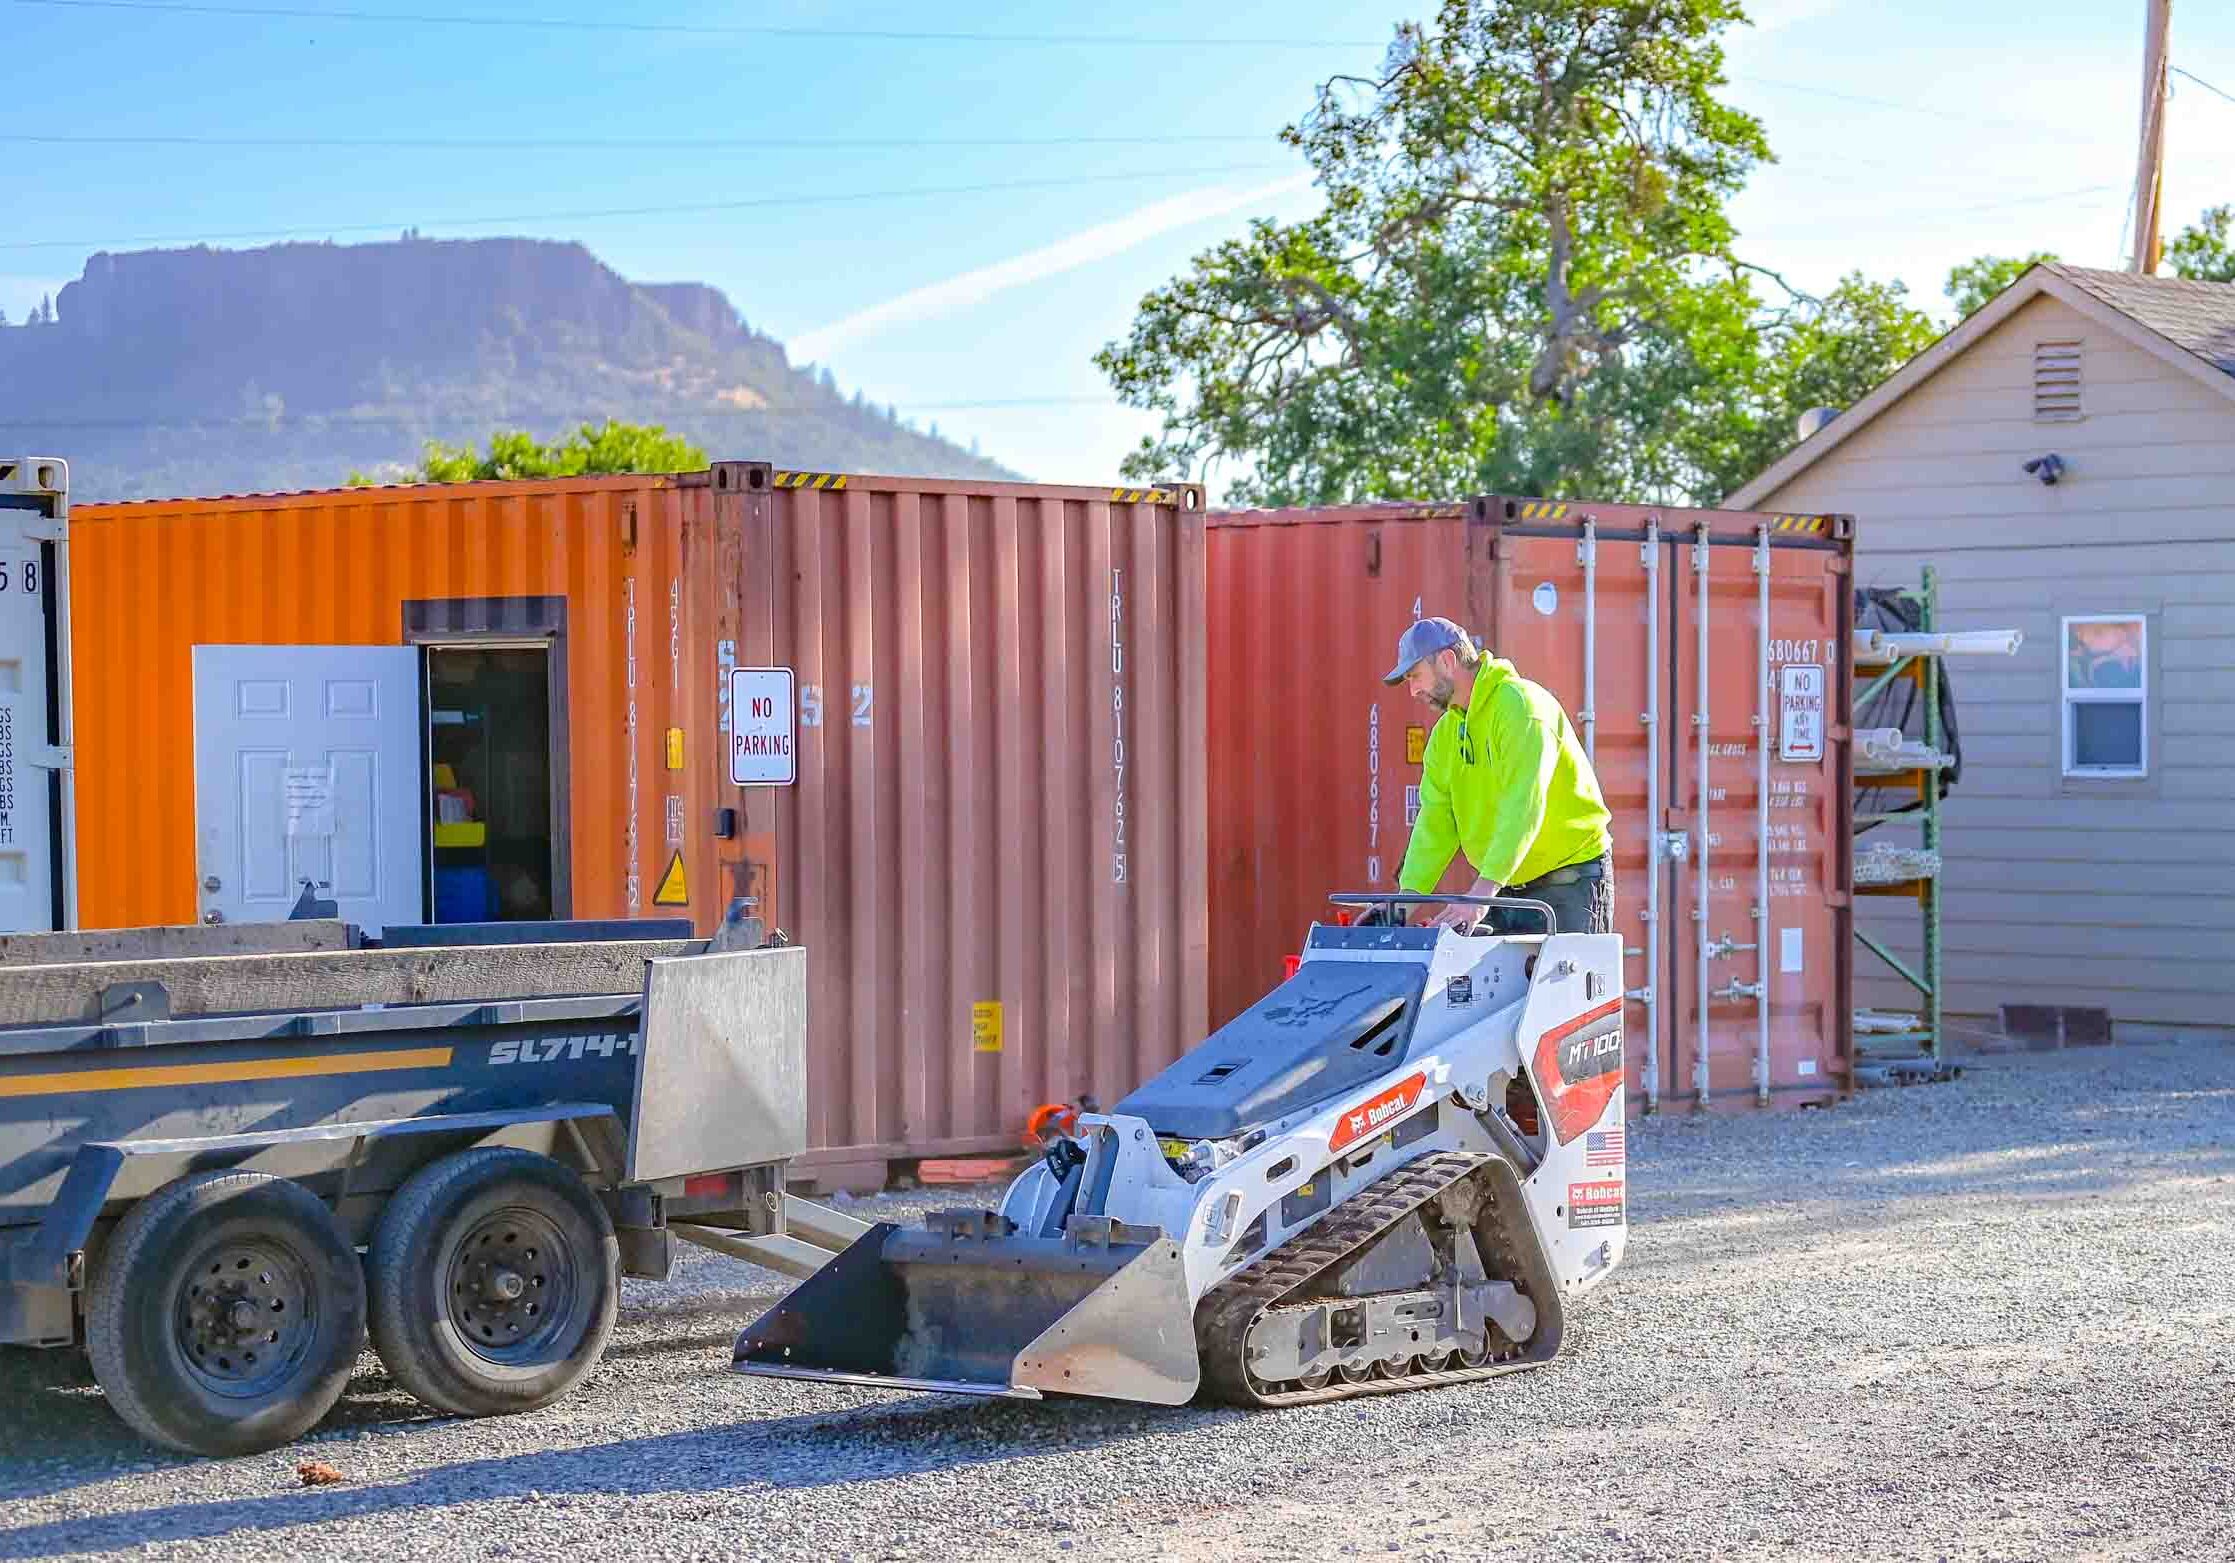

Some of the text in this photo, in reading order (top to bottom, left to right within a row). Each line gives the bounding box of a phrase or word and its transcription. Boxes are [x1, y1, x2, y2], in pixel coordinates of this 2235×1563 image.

[25, 562, 37, 592] 8
[626, 576, 637, 688] TRLU
[1767, 639, 1818, 662] 680667
[1794, 671, 1811, 691] NO
[752, 696, 772, 719] NO
[1784, 695, 1821, 712] PARKING
[1112, 568, 1125, 881] TRLU 810762 5
[736, 735, 790, 756] PARKING
[1369, 703, 1379, 847] 680667
[1367, 1093, 1407, 1126] Bobcat
